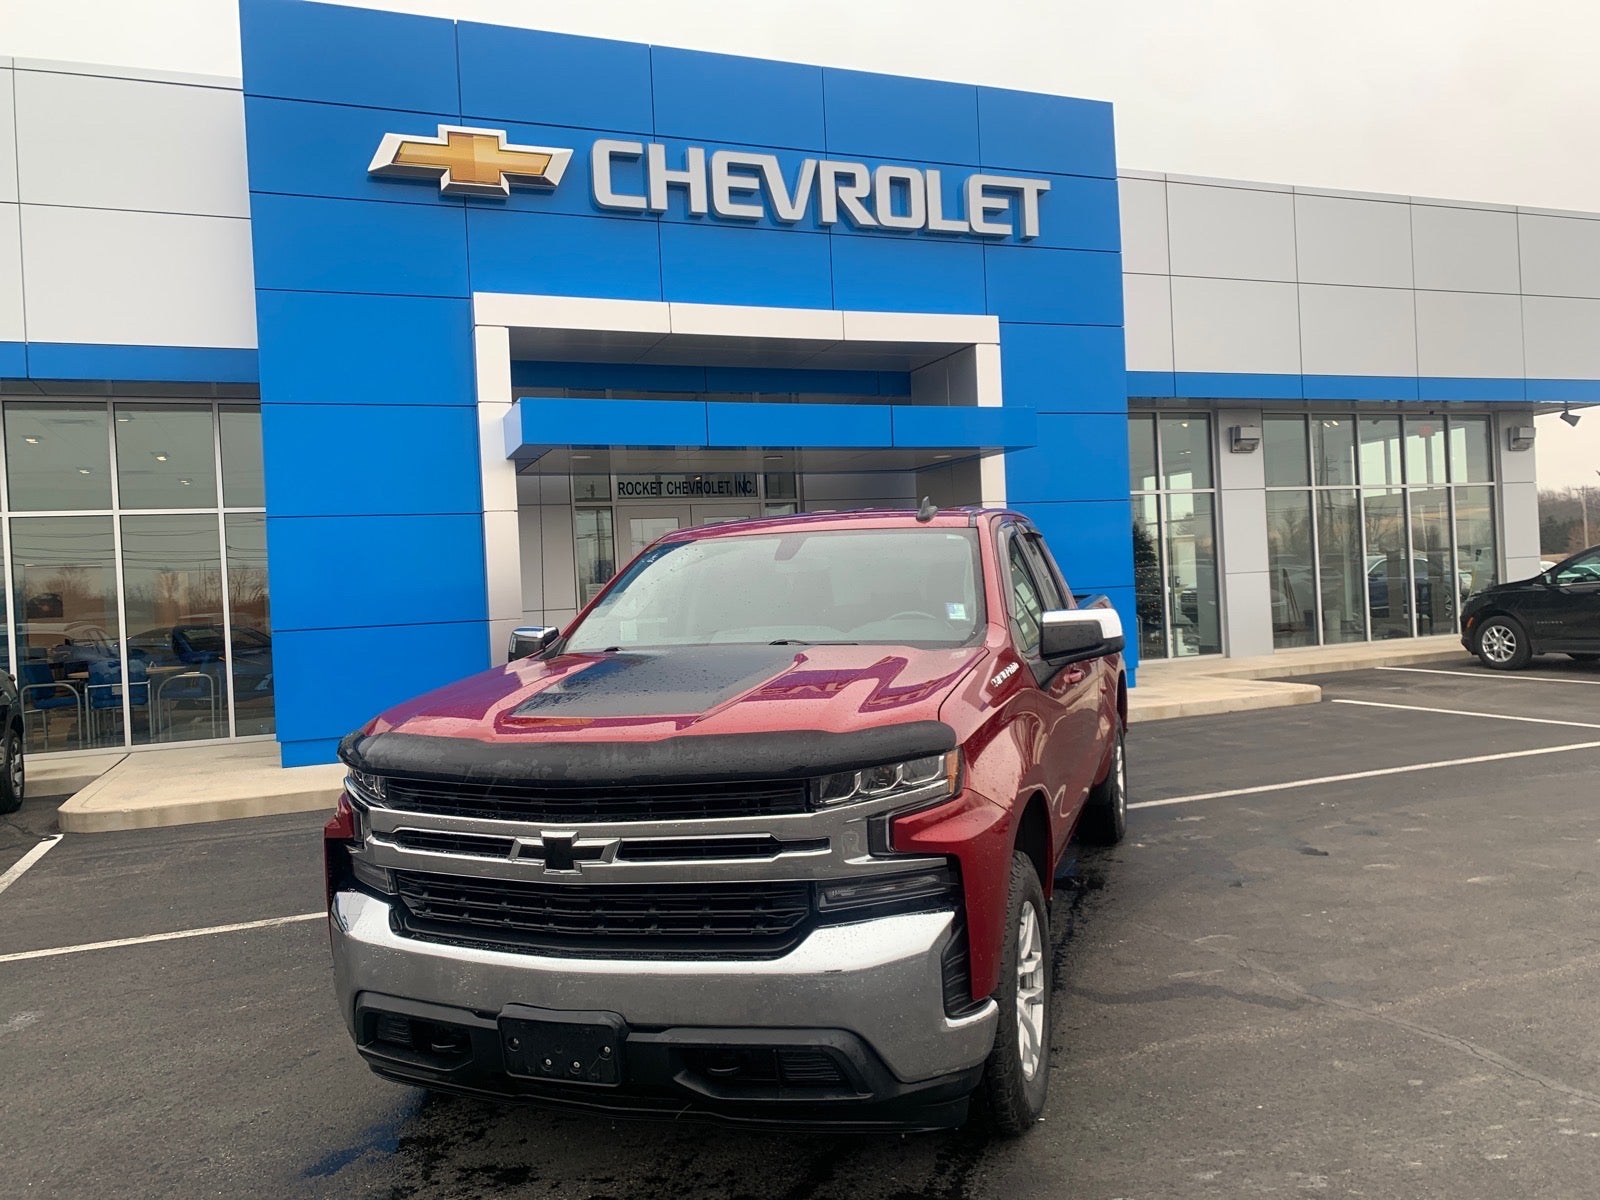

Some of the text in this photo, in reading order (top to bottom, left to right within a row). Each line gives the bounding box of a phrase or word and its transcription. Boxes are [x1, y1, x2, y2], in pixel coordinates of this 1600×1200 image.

[591, 138, 1051, 240] CHEVROLET
[618, 481, 663, 496] ROCKET
[735, 480, 755, 494] INC.
